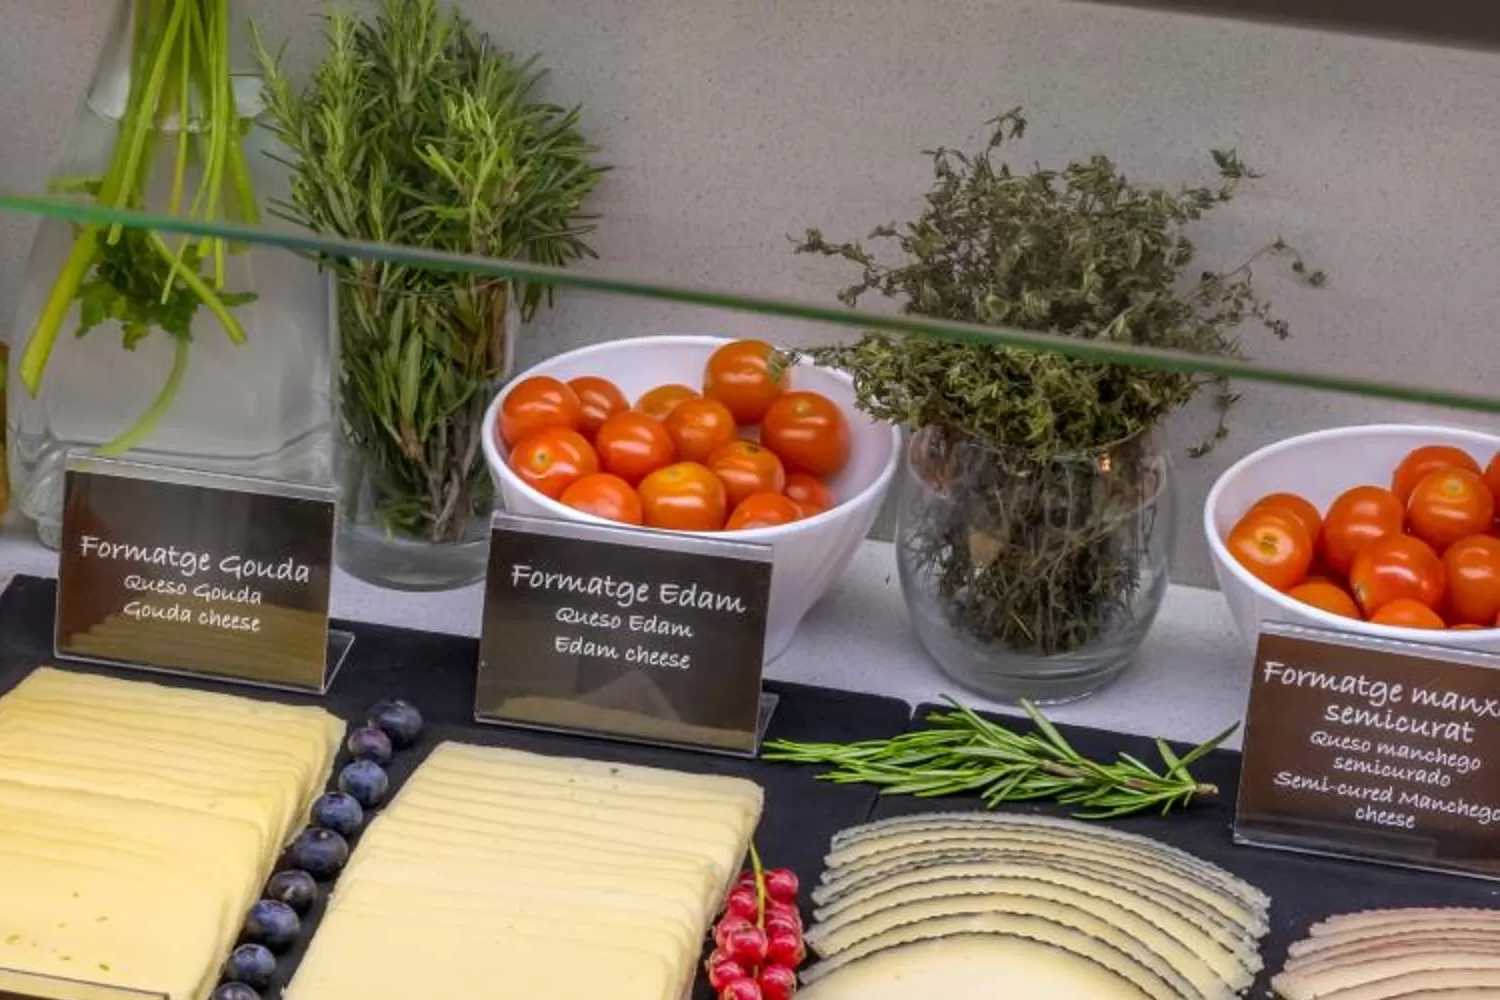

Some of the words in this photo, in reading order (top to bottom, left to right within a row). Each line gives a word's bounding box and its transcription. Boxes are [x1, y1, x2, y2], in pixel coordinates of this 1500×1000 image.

[80, 535, 211, 577] Formatge
[219, 555, 310, 583] Gouda
[124, 575, 187, 597] Queso
[193, 584, 262, 606] Gouda
[511, 563, 649, 607] Formatge
[659, 582, 747, 614] Edam
[123, 601, 192, 621] Gouda
[198, 608, 261, 632] cheese
[555, 607, 621, 629] Queso
[629, 615, 693, 638] Edam
[555, 636, 619, 660] Edam
[625, 645, 691, 670] cheese
[1263, 660, 1403, 707] Formatge
[1411, 686, 1500, 718] manx
[1324, 704, 1477, 743] semicurat
[1310, 731, 1372, 752] Queso
[1376, 742, 1482, 775] manchego
[1332, 755, 1452, 788] semicurado
[1273, 771, 1394, 804] Semi-cured
[1399, 791, 1500, 825] Manchego
[1355, 804, 1416, 829] cheese
